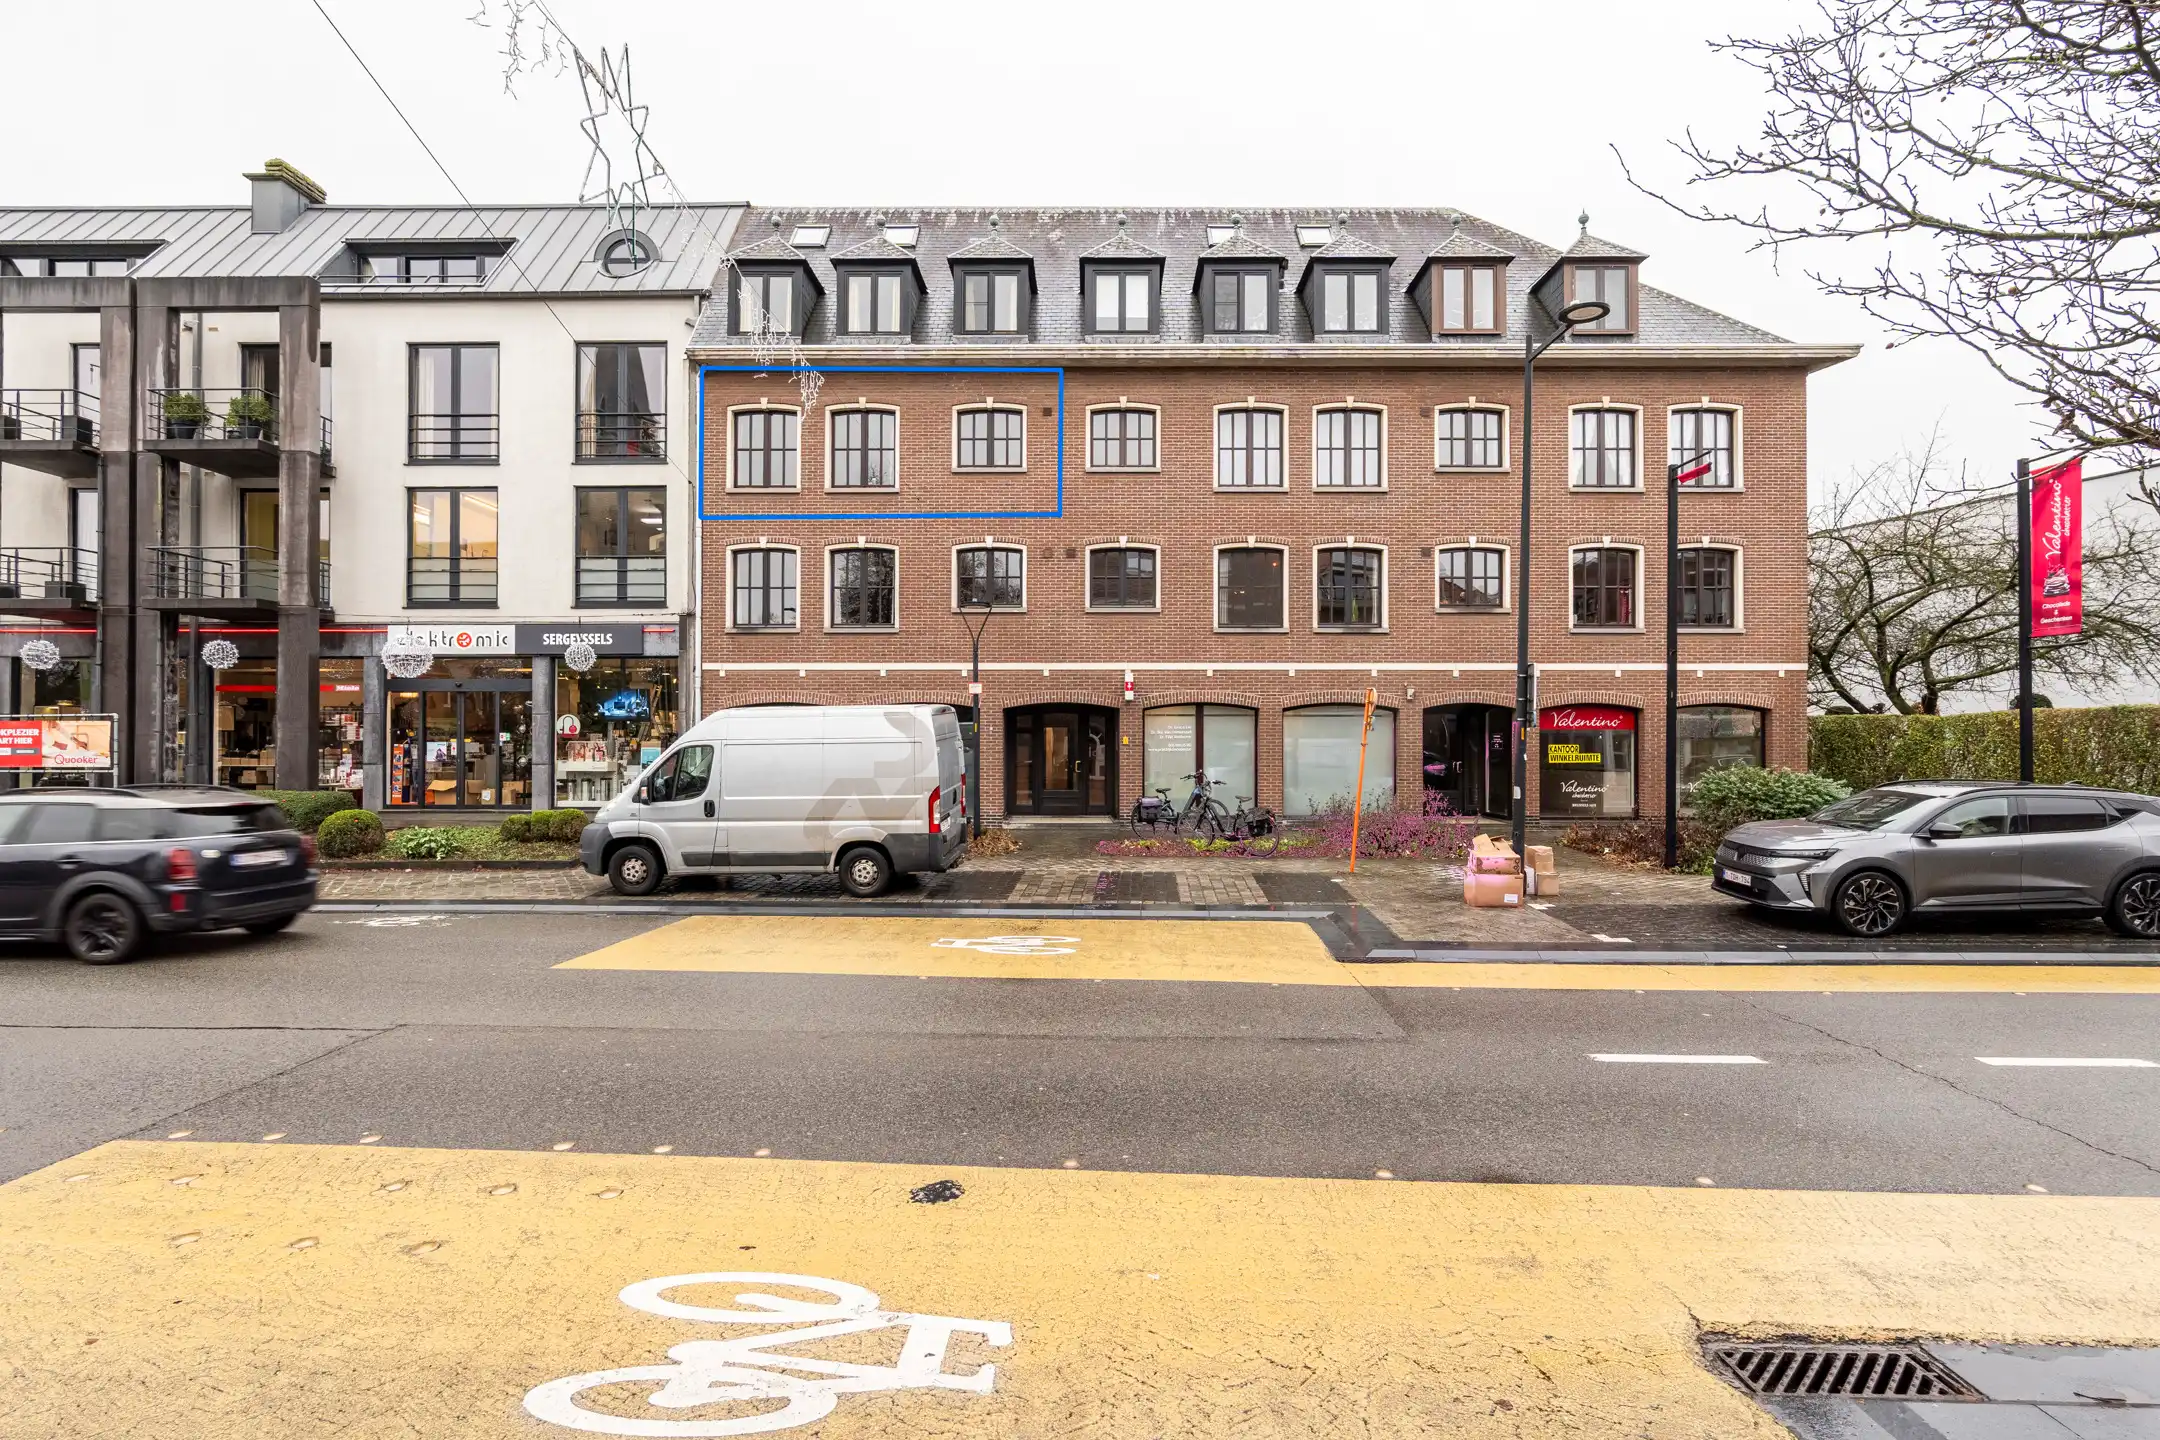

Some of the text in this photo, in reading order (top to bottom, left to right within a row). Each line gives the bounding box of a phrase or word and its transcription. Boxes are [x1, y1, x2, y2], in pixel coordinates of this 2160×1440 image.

[2042, 480, 2061, 559] Valentino
[542, 633, 613, 645] SERGEYSSELS
[1551, 709, 1620, 727] Valentino
[0, 728, 39, 736] KPLEZIER
[1549, 745, 1580, 754] KANTOOR
[54, 753, 98, 765] Quooker
[1549, 754, 1600, 762] WINKELRUIMTE
[1560, 780, 1608, 793] Valentino
